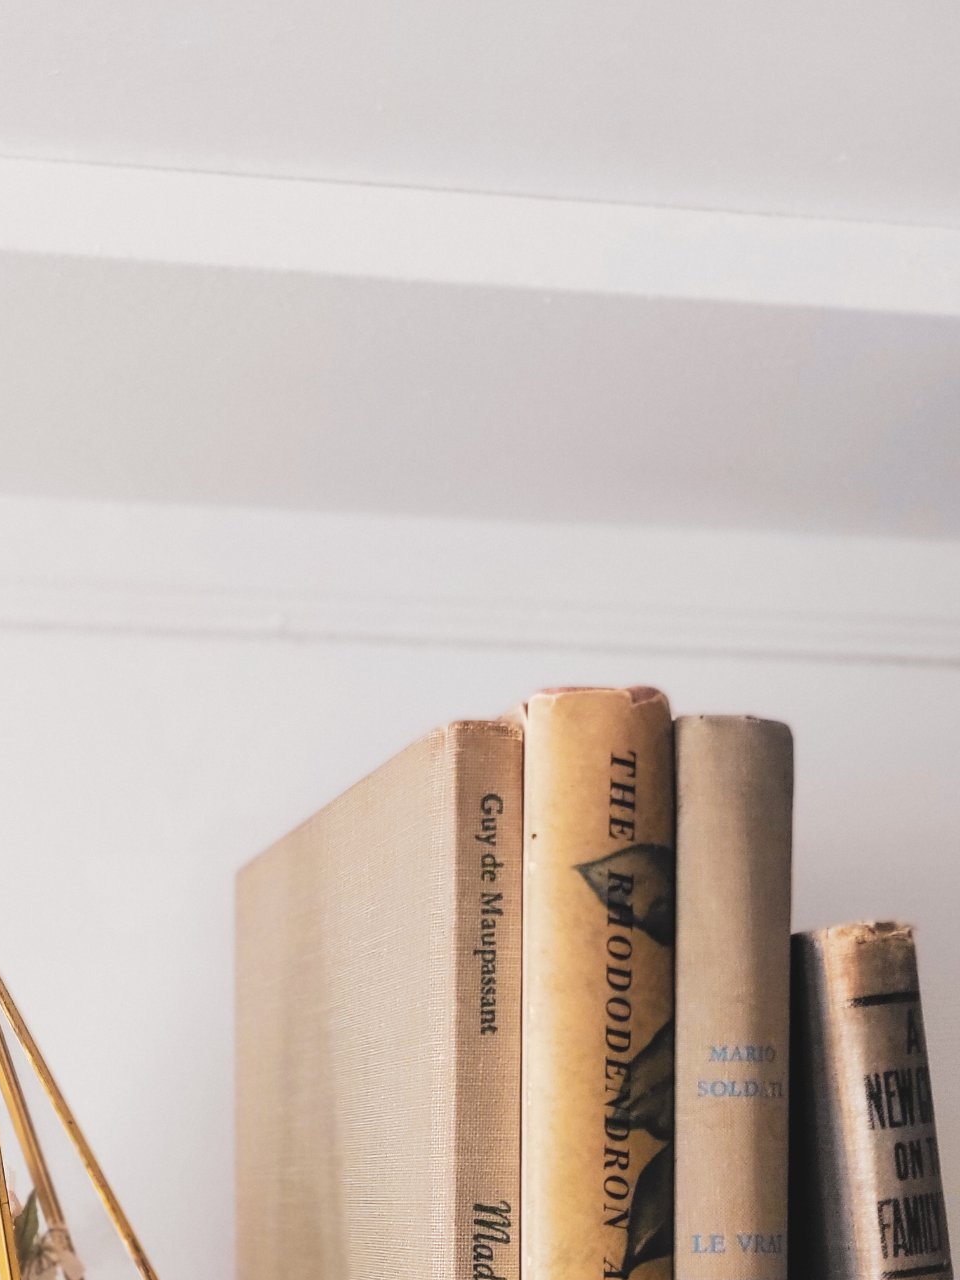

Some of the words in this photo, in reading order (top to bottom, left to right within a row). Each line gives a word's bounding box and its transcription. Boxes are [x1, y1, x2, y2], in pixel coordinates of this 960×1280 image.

[474, 793, 504, 845] Guy
[607, 750, 637, 842] THE
[480, 853, 504, 882] de
[474, 892, 504, 1036] Maupassant
[603, 869, 634, 1230] RHODODENDRON
[708, 1045, 776, 1062] MARIO
[691, 1233, 726, 1253] LE
[736, 1233, 783, 1254] VRAI
